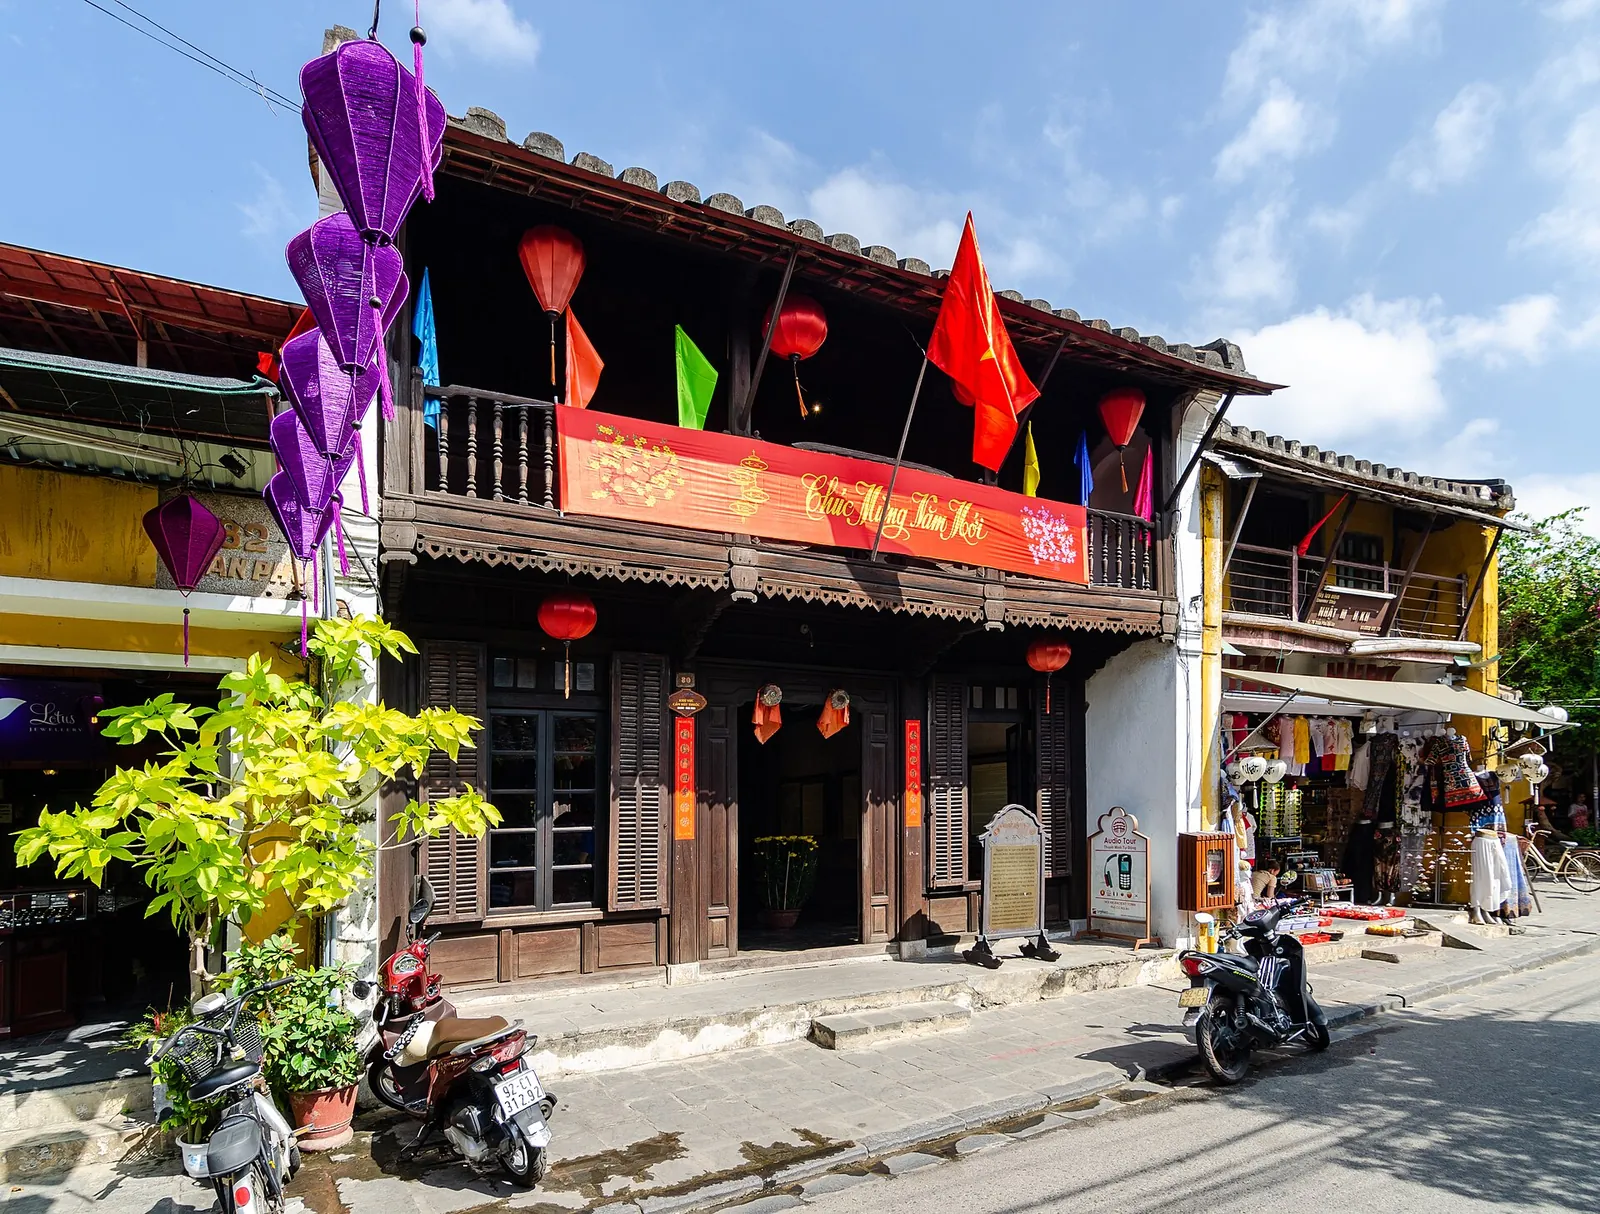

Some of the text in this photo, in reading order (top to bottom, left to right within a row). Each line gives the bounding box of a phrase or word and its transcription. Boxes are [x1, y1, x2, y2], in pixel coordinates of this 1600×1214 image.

[801, 473, 855, 521] Chúc
[909, 491, 948, 533] Năm
[939, 499, 989, 546] Mới
[681, 676, 691, 684] 80
[30, 702, 76, 725] Lotus
[503, 1076, 532, 1098] 92-C1
[505, 1086, 542, 1113] 312.92
